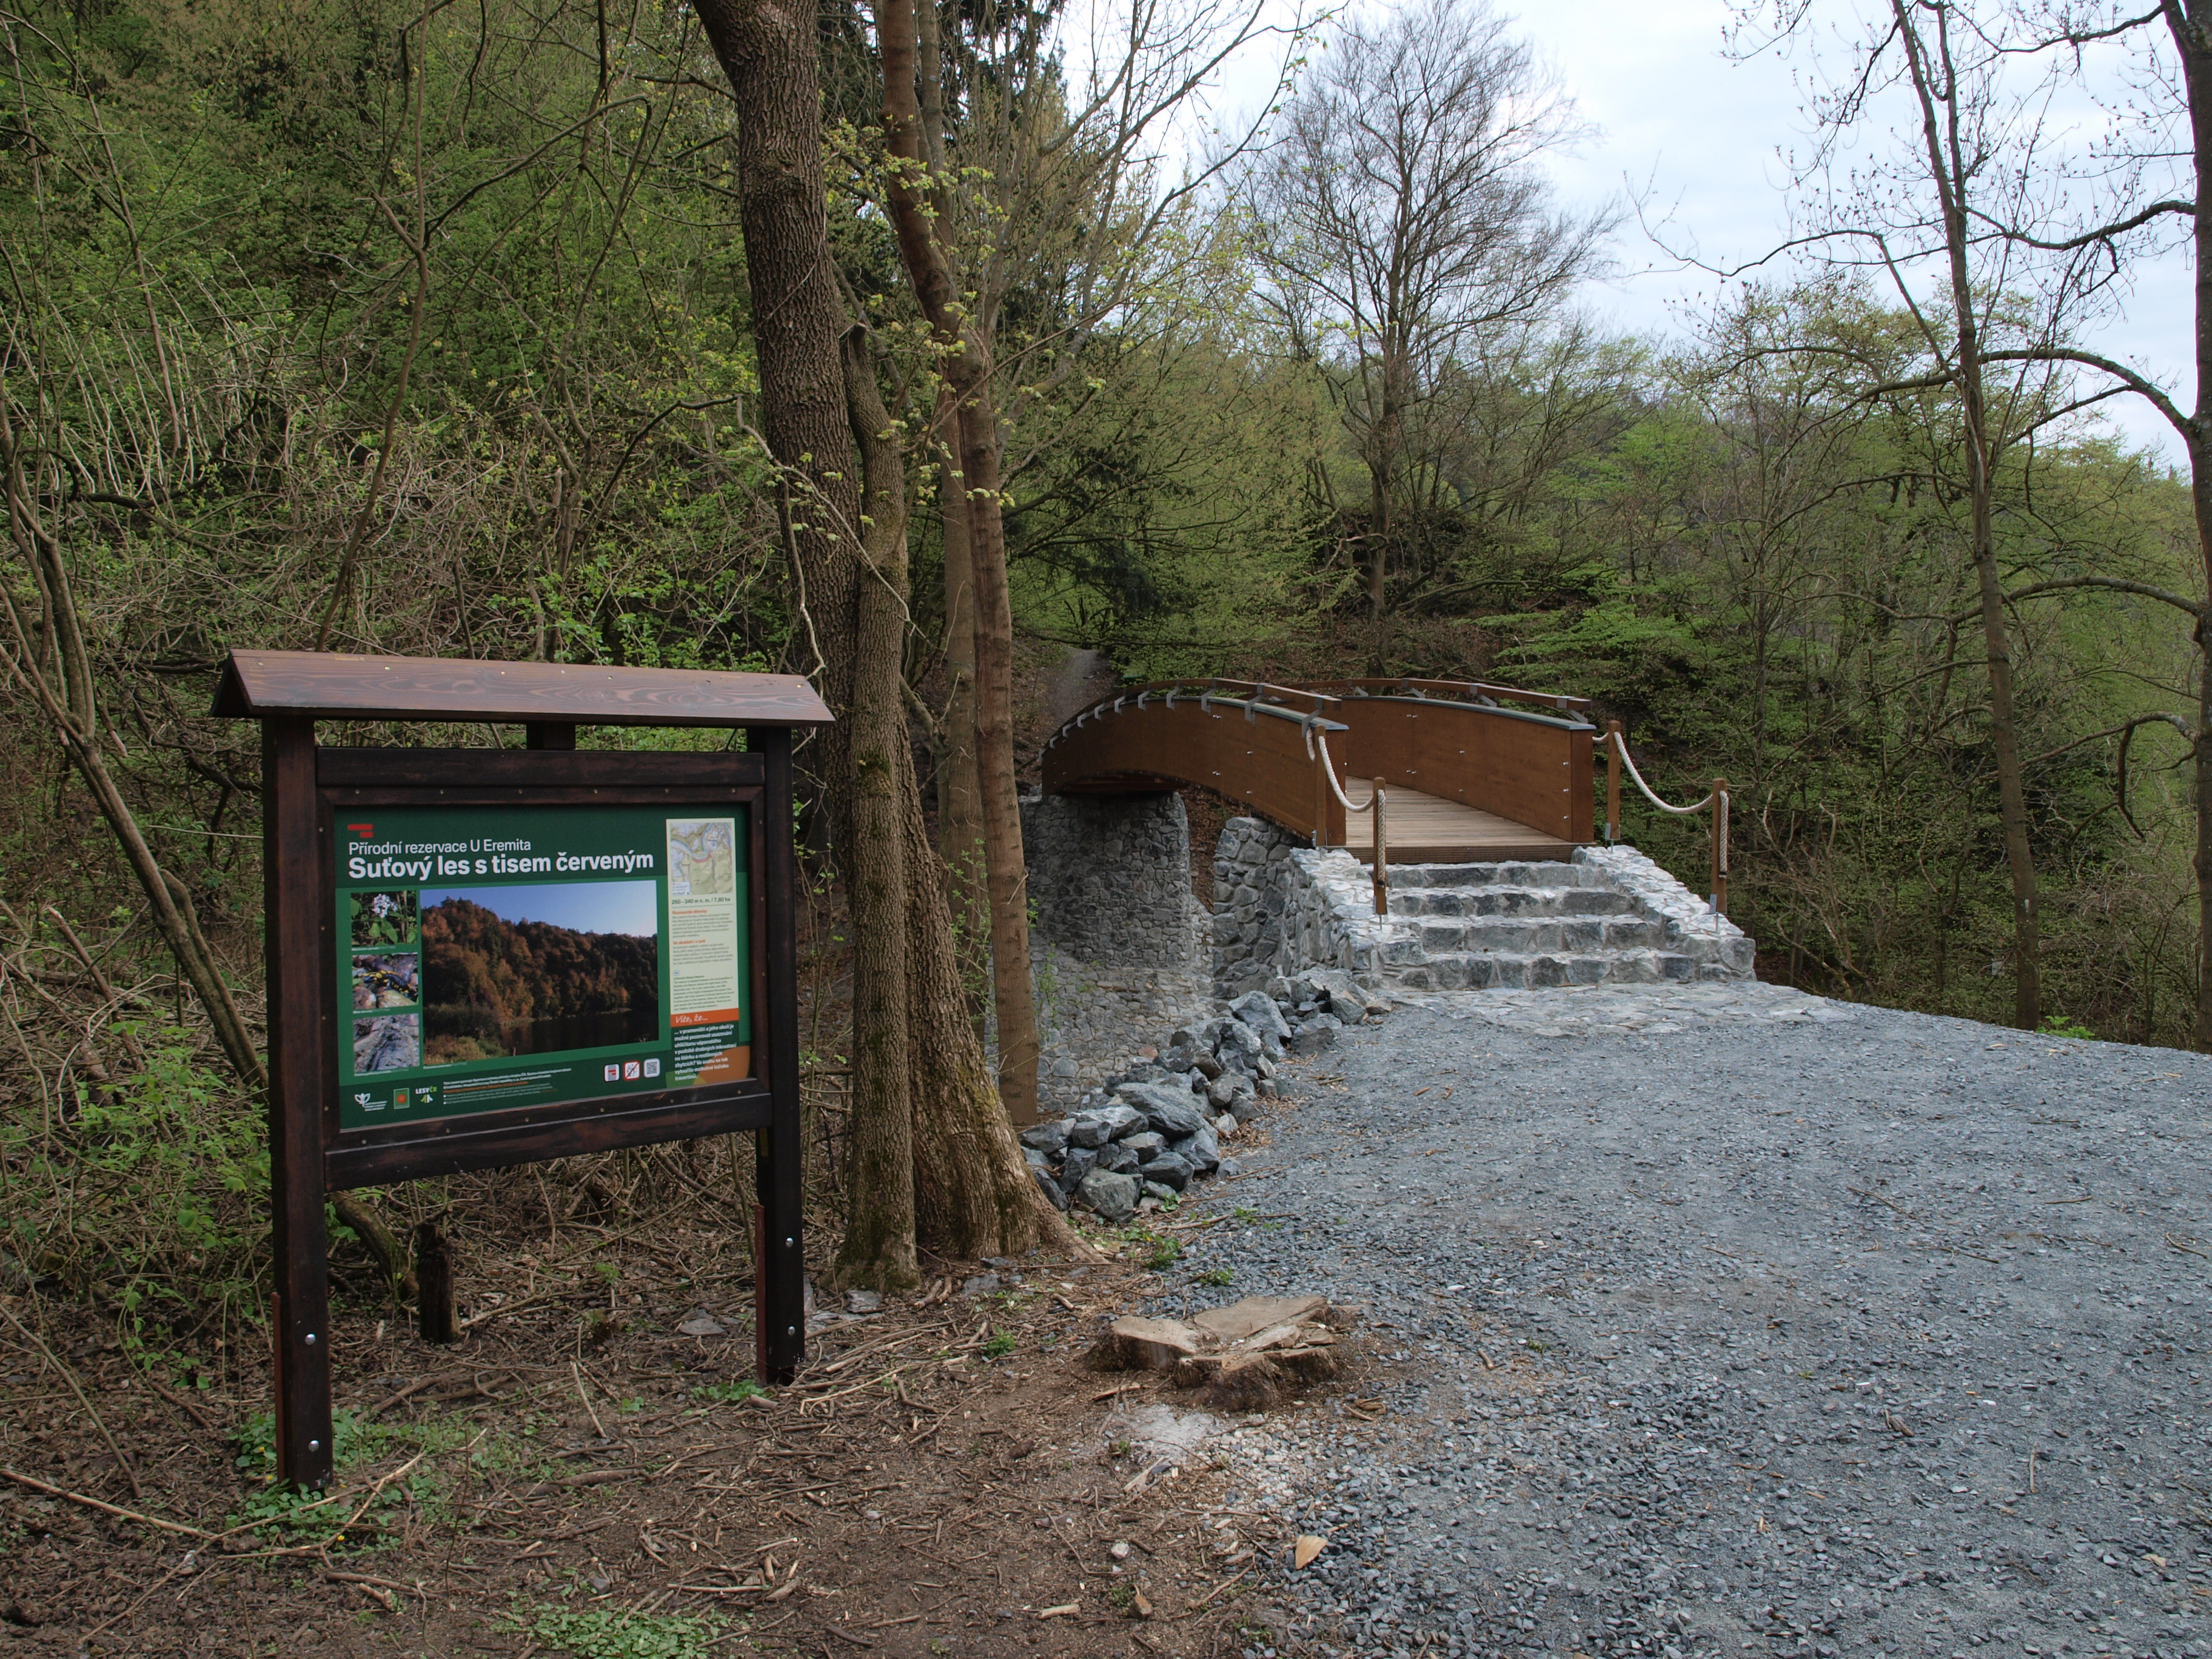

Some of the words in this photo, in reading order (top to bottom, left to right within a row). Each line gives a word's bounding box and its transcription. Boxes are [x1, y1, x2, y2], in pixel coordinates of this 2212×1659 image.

[349, 841, 403, 855] Přírodní
[405, 842, 467, 854] rezervace
[470, 839, 480, 852] U
[483, 839, 531, 852] Eremita
[348, 856, 433, 881] Suťový
[438, 855, 471, 876] les
[475, 858, 488, 874] s
[491, 854, 551, 874] tisem
[556, 850, 654, 873] červeným
